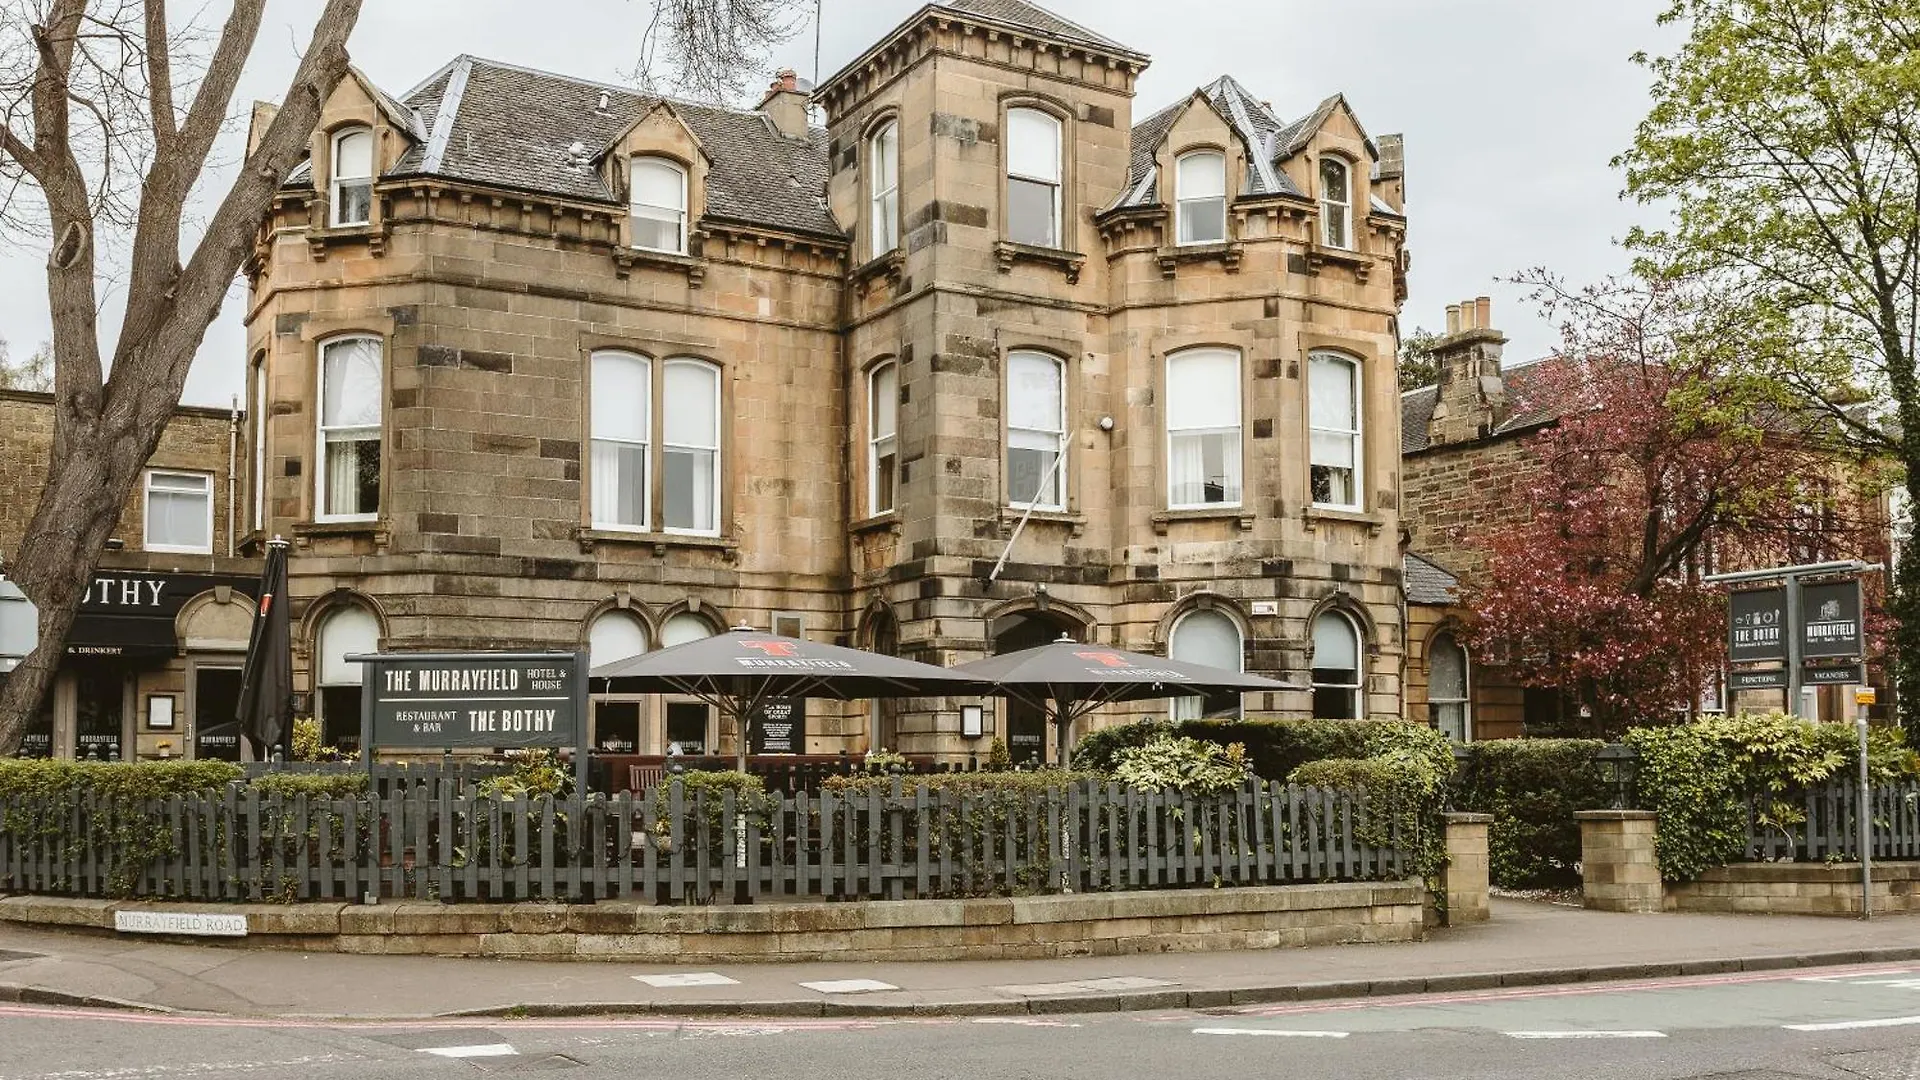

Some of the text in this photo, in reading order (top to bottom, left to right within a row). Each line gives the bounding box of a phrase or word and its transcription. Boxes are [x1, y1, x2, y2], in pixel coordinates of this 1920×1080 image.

[1735, 628, 1779, 641] THE BOTHY
[1807, 623, 1855, 637] MURRAYFIELD
[385, 669, 519, 691] THE MURRAYFIELD
[527, 669, 567, 679] HOTEL &
[532, 680, 562, 690] HOUSE
[396, 711, 457, 721] RESTAURANT
[469, 709, 556, 731] THE BOTHY
[413, 723, 441, 732] & BAR
[118, 914, 243, 931] MURRAYFIELD ROAD
